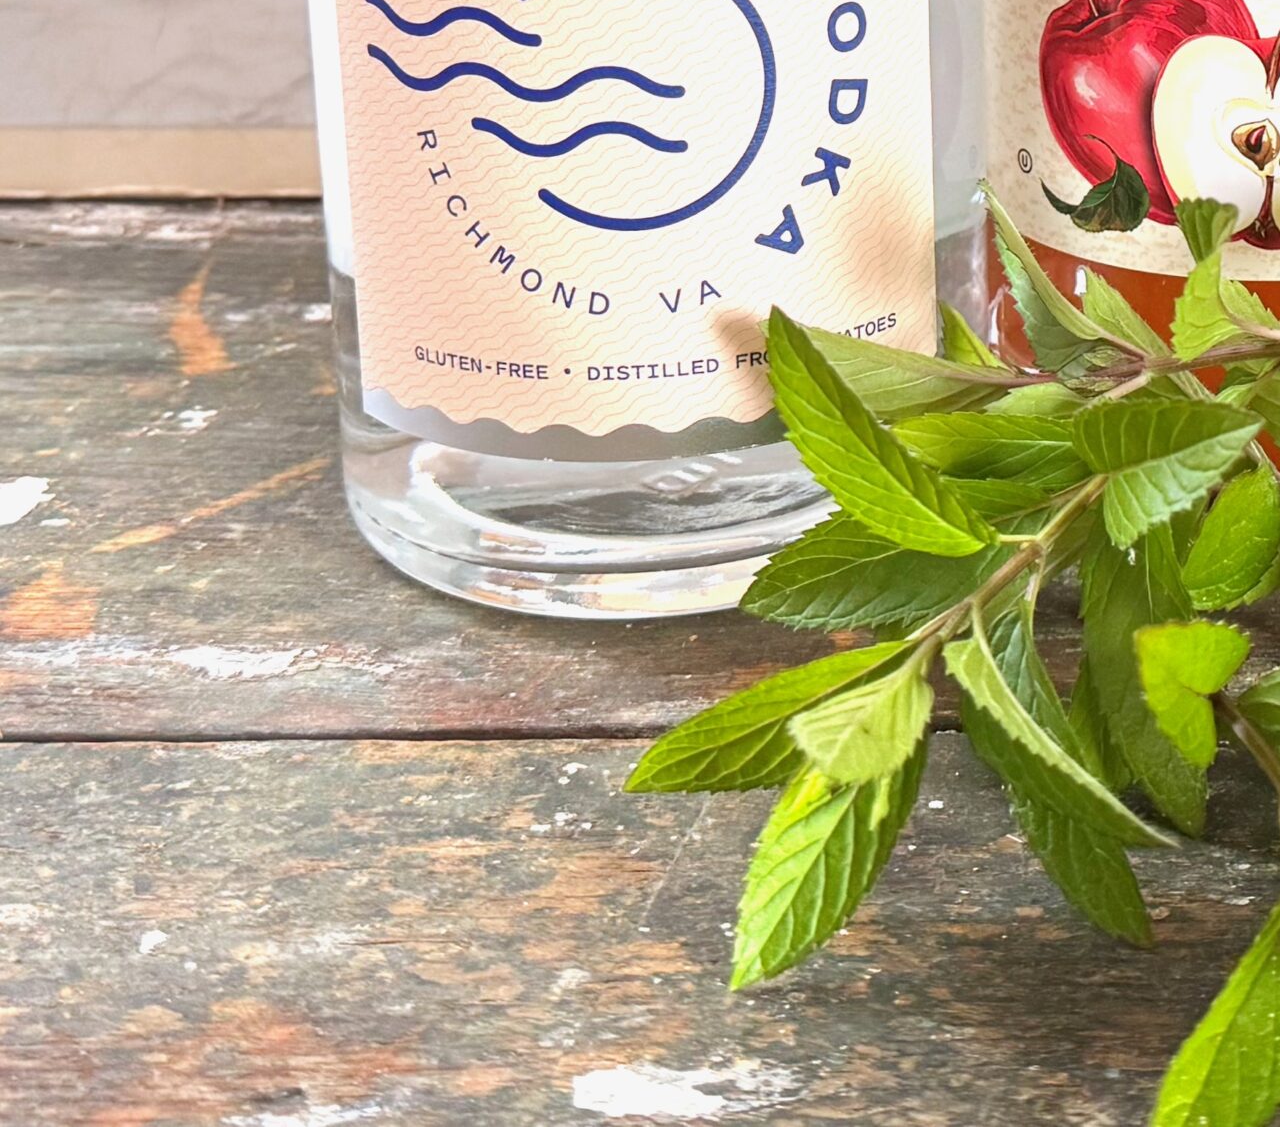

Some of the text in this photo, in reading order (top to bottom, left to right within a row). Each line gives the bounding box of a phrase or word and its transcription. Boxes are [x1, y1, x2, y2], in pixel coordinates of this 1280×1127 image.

[415, 128, 722, 317] RICHMOND VA
[414, 344, 550, 381] GLUTEN-FREE
[586, 357, 720, 382] DISTILLED
